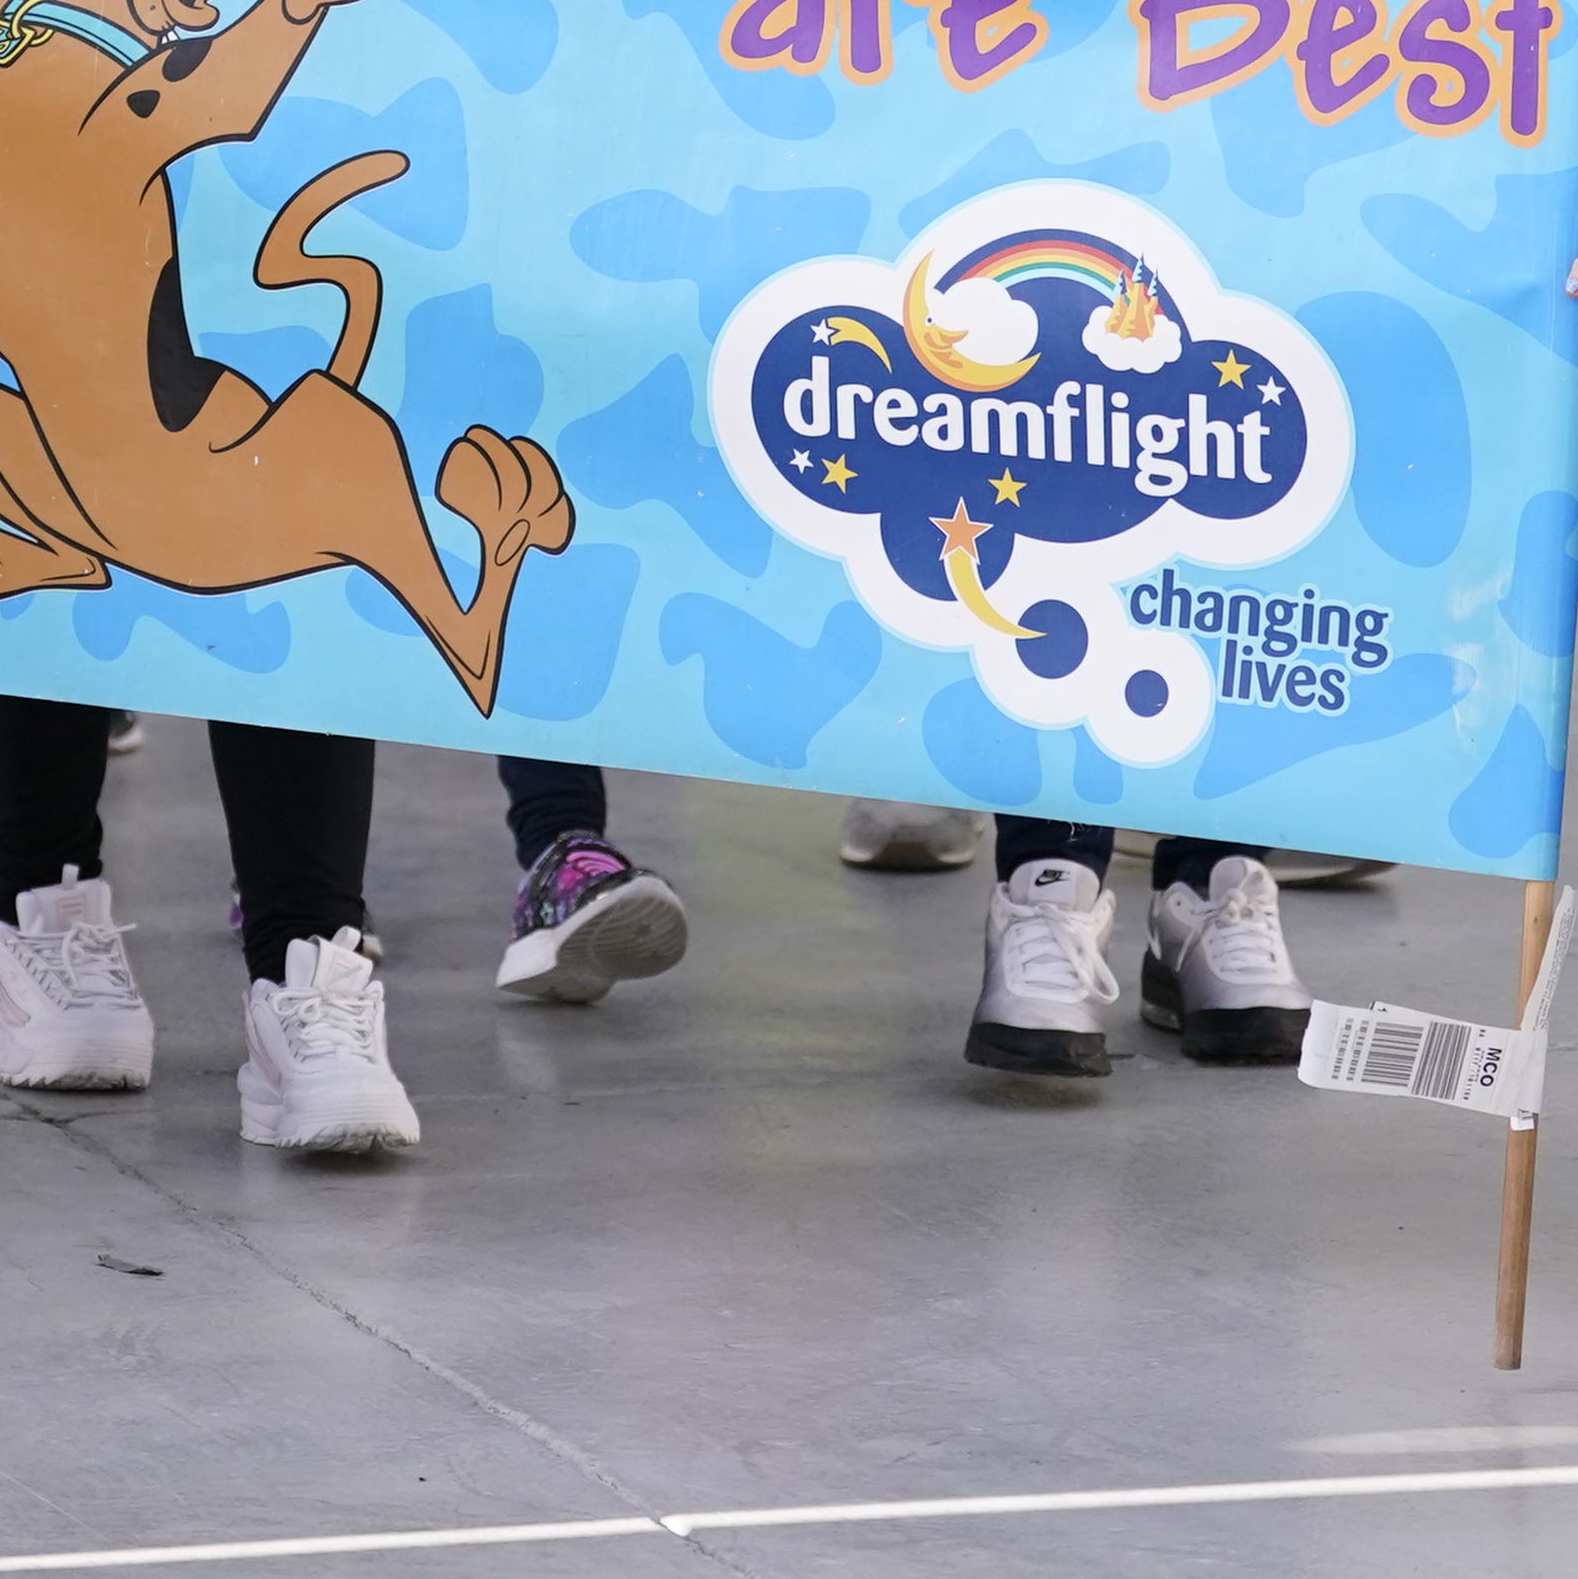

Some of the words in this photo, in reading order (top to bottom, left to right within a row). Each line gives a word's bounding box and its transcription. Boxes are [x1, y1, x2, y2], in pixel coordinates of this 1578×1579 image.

[782, 355, 1273, 498] dreamflight
[1129, 568, 1389, 668] changing
[1221, 646, 1347, 712] lives
[1480, 1047, 1502, 1087] MCO
